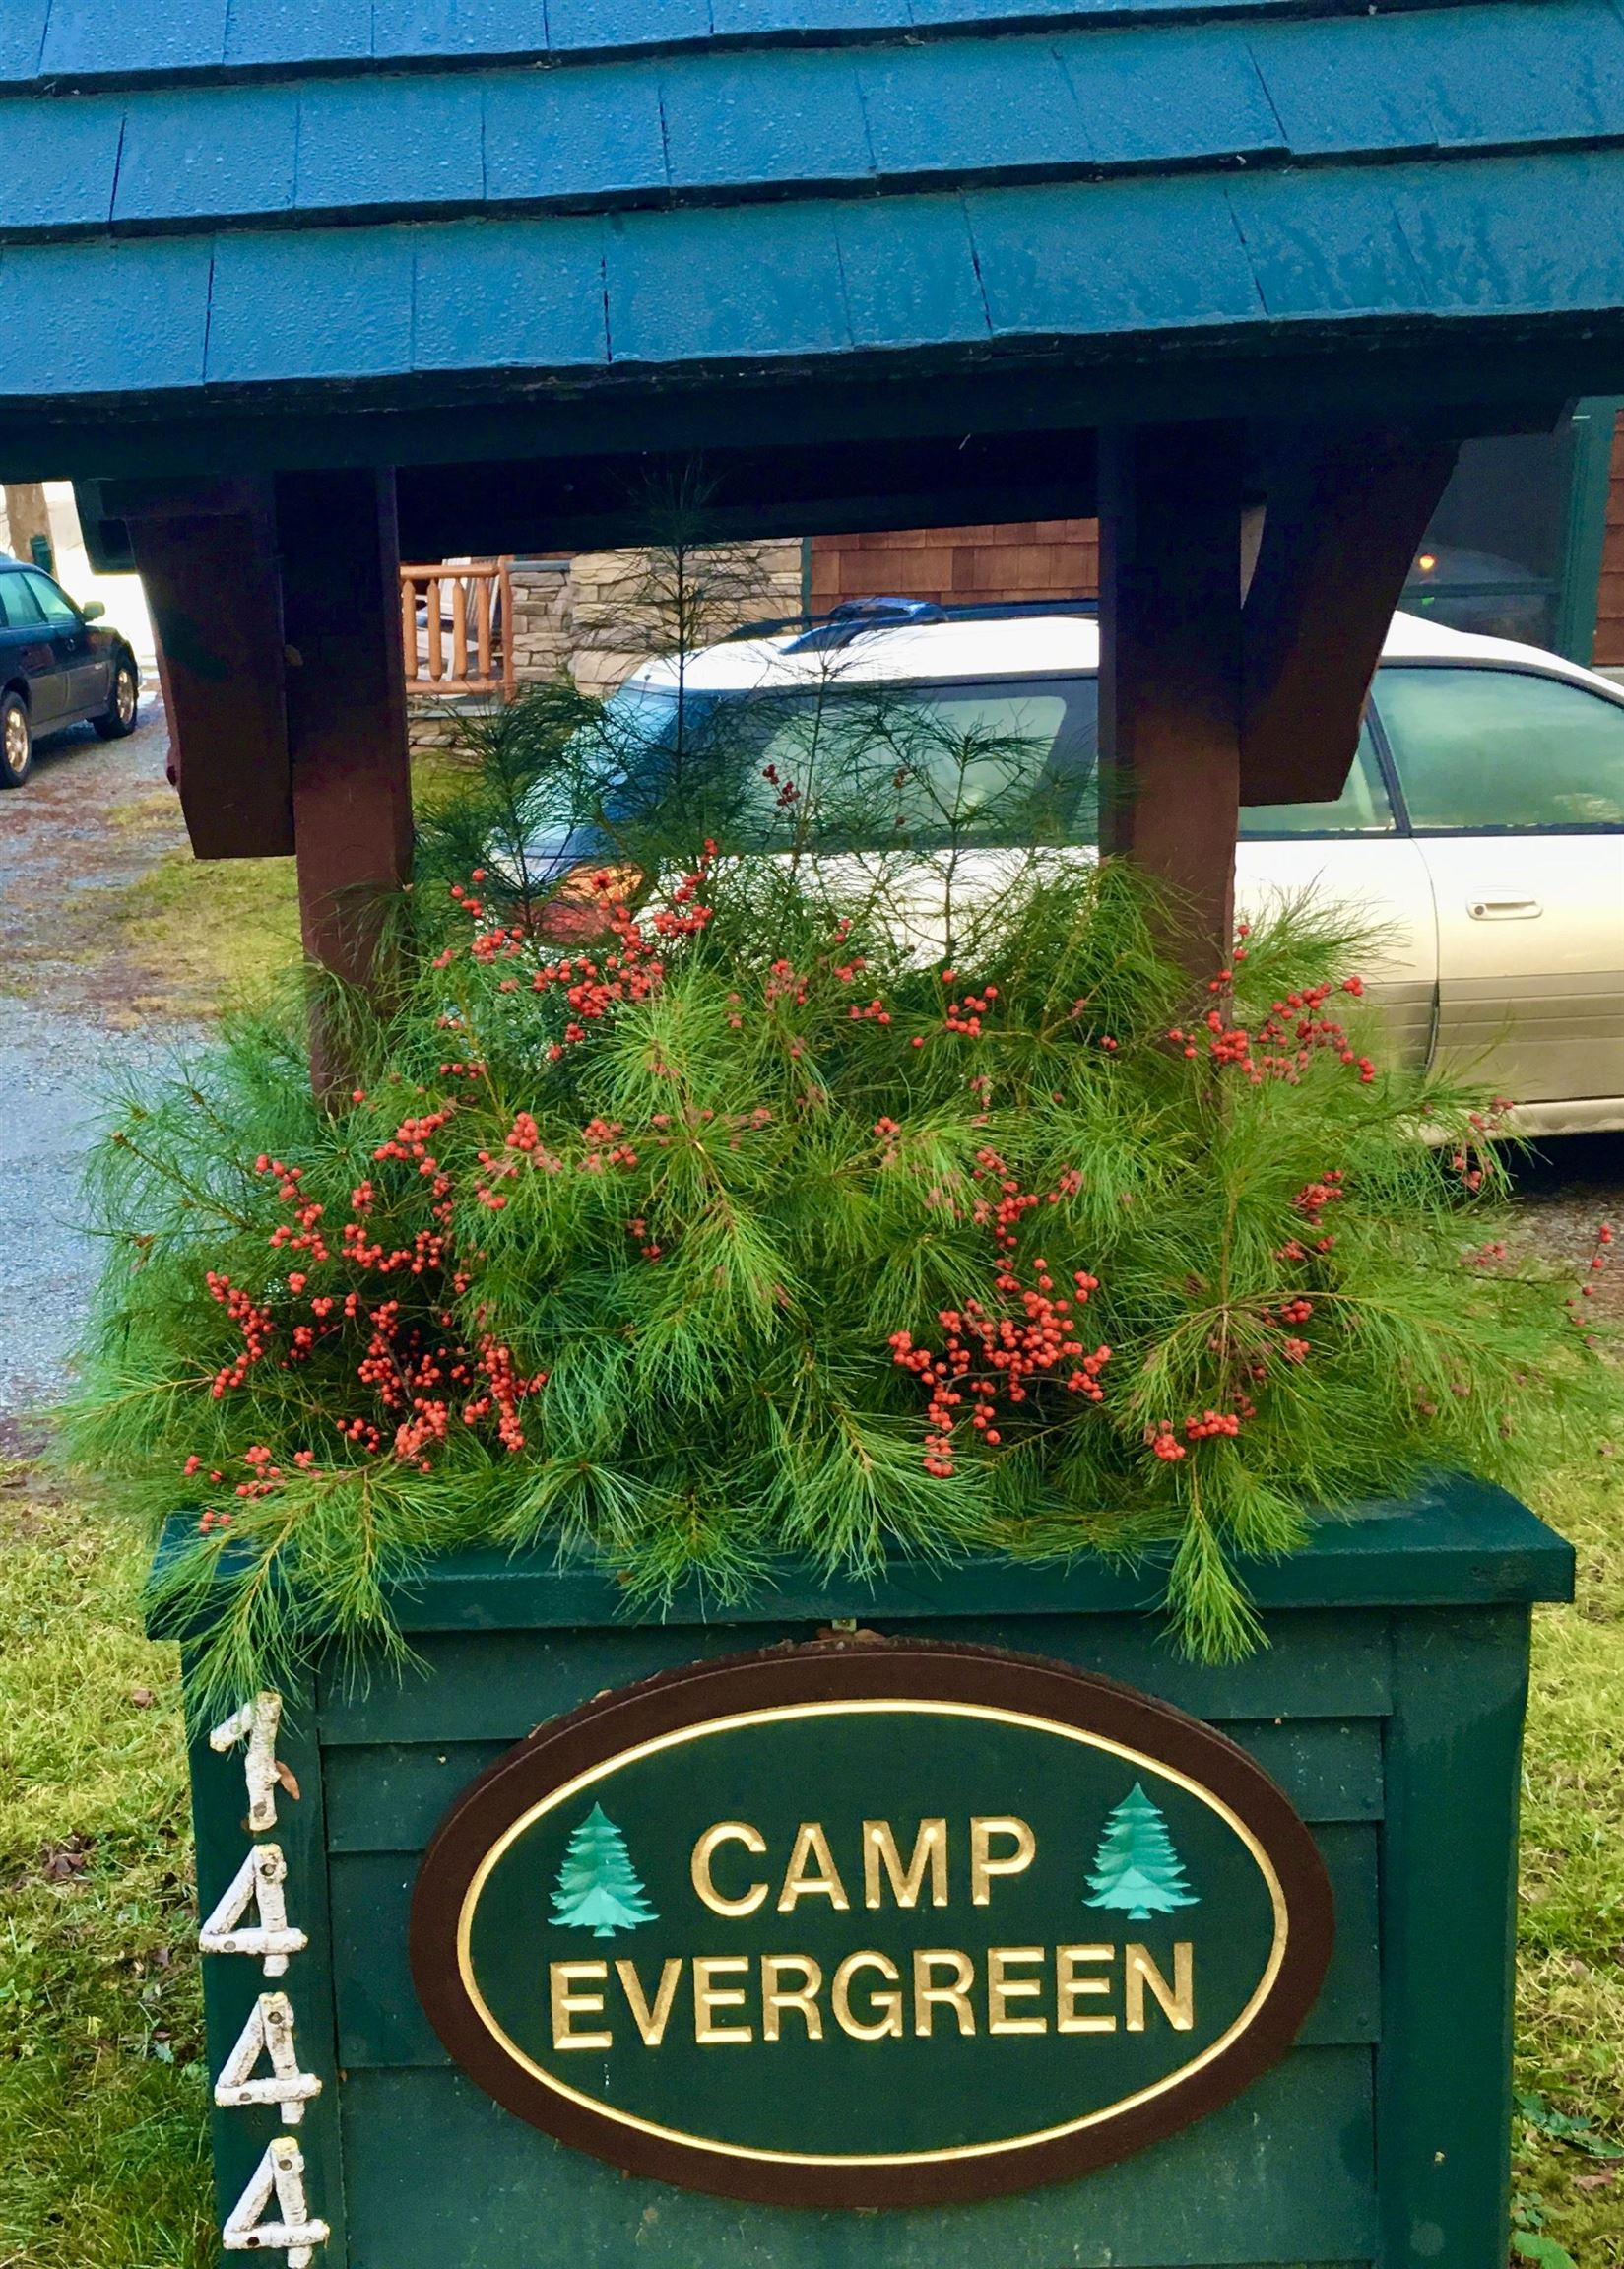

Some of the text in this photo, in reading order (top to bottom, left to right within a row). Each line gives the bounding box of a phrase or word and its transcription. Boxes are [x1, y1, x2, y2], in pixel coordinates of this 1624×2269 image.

[691, 1816, 1036, 1916] CAMP
[199, 1691, 330, 2269] 1444
[550, 1942, 1194, 2051] EVERGREEN
